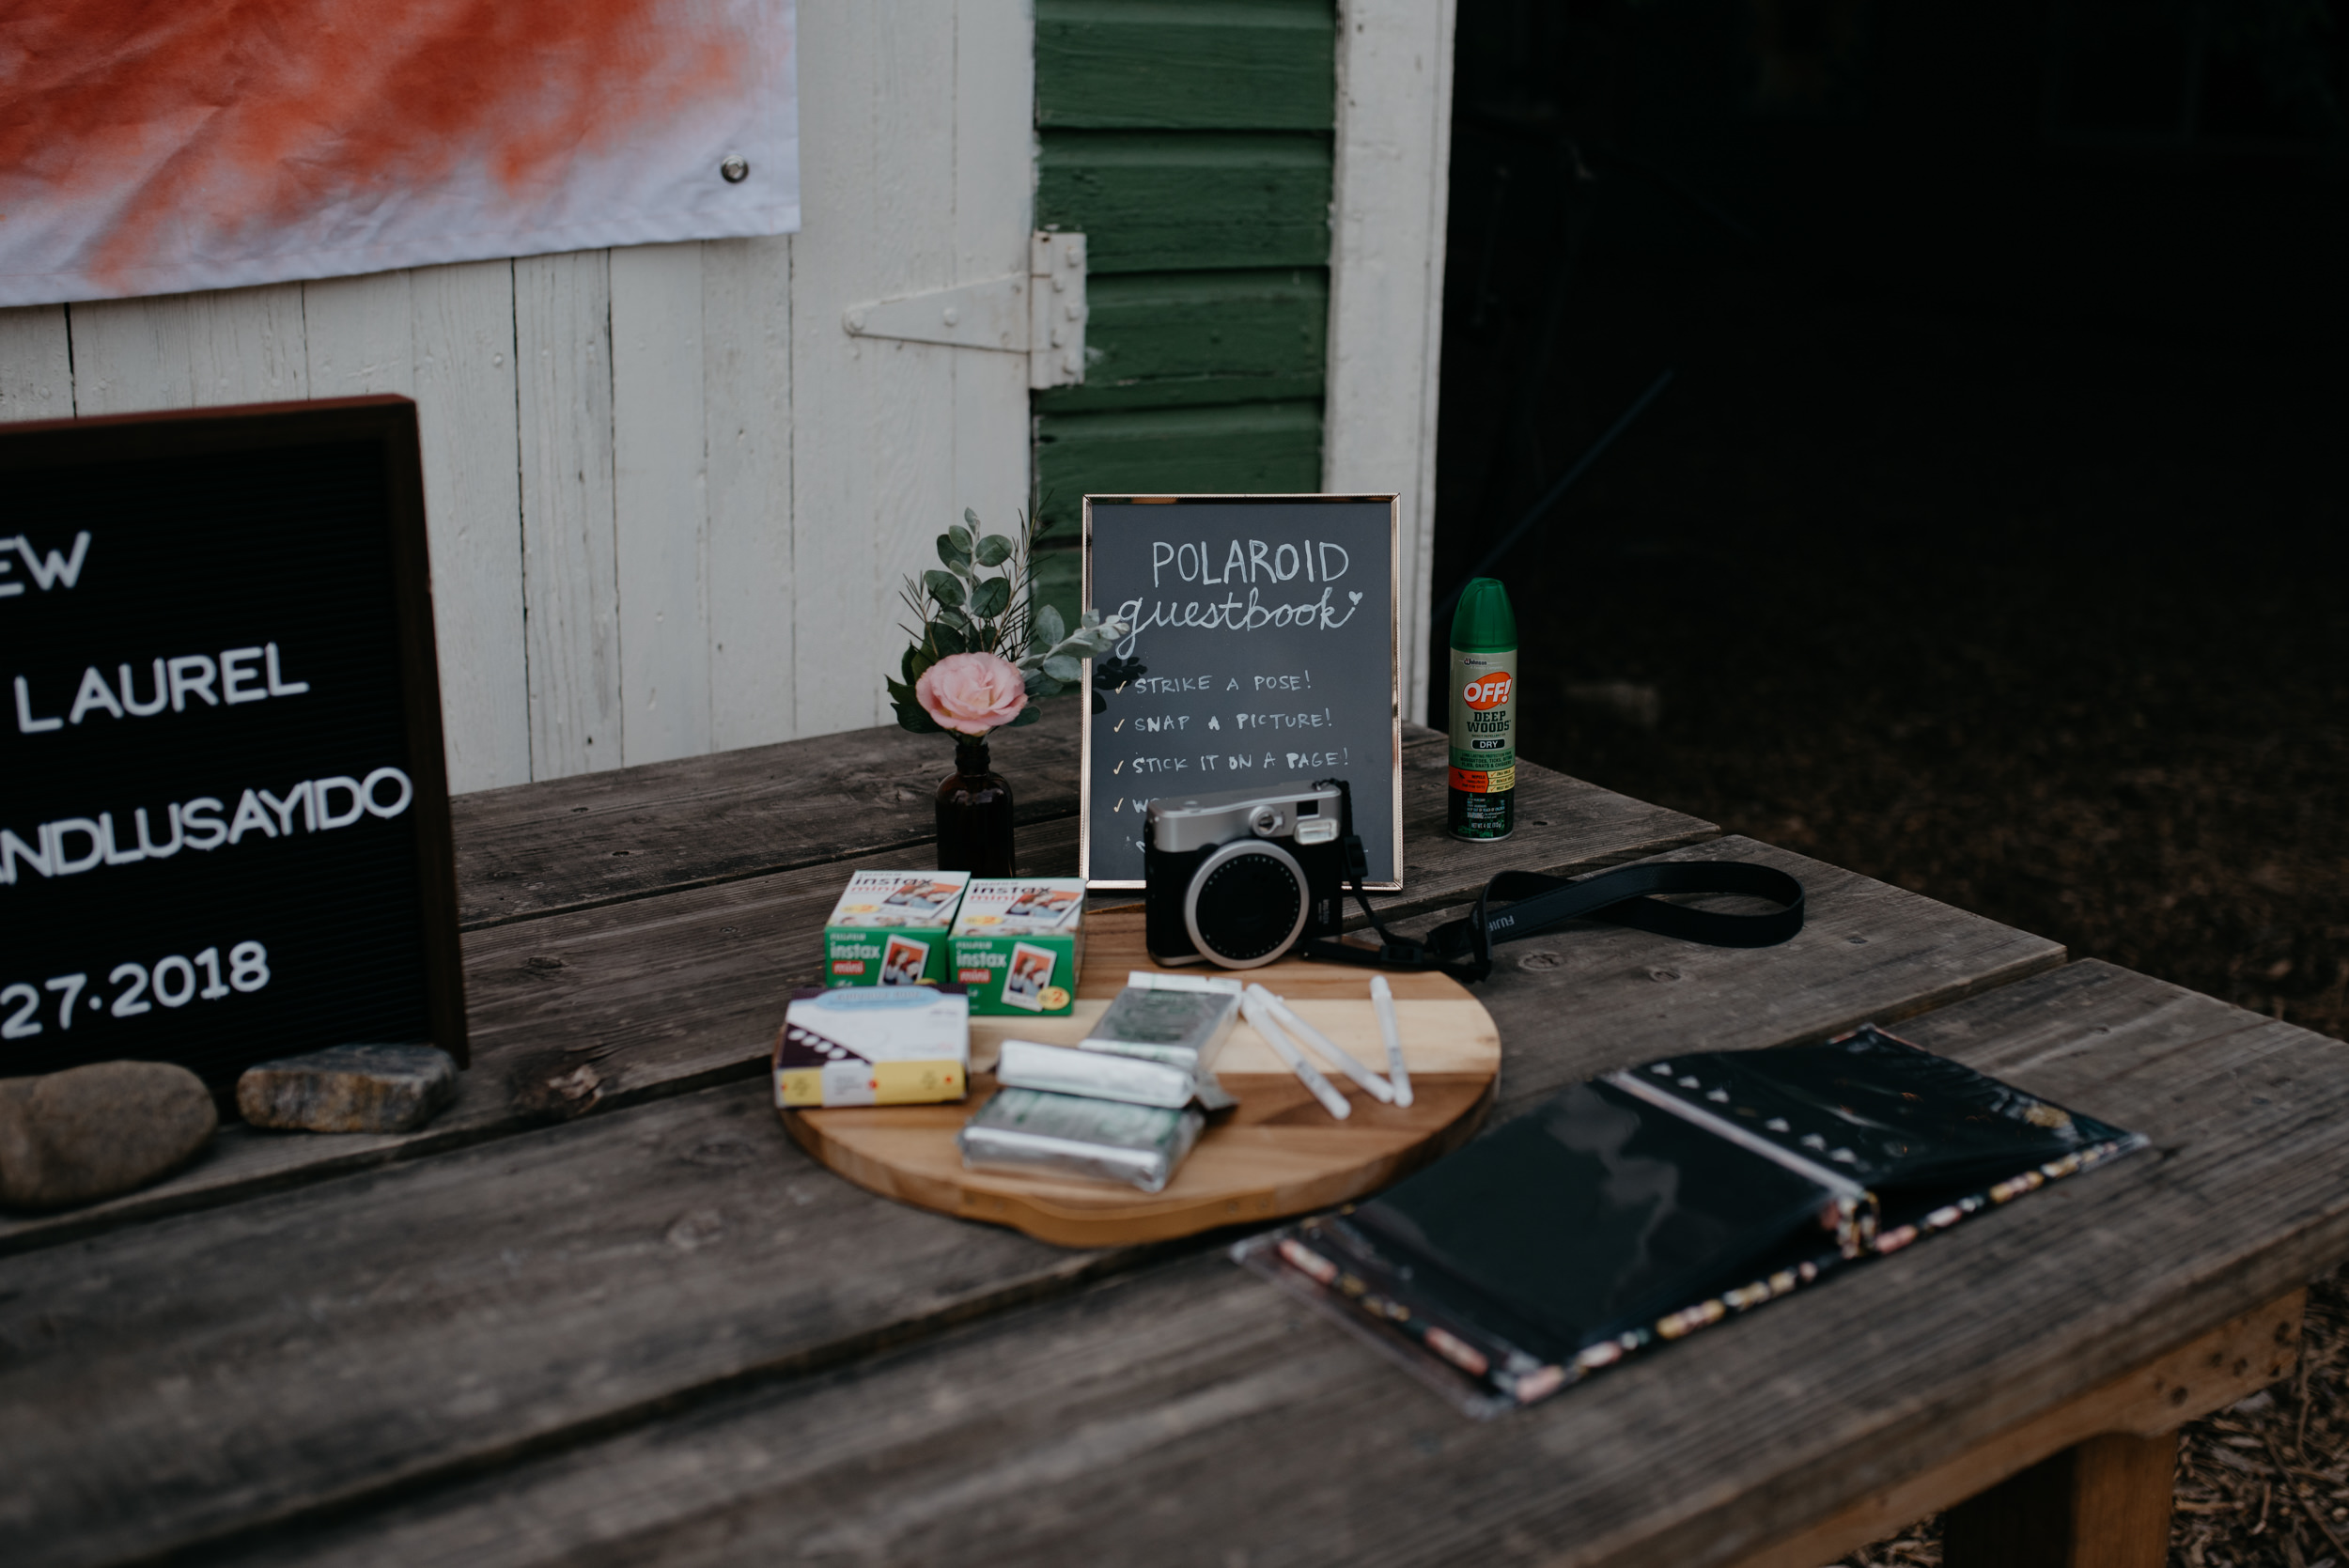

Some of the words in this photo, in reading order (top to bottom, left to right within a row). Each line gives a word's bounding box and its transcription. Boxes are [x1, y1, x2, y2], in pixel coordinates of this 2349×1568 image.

[1152, 539, 1349, 588] POLAROID
[1114, 586, 1356, 660] guestbook
[14, 642, 310, 734] LAUREL
[1134, 675, 1212, 694] STRIKE
[1226, 677, 1239, 691] A
[1254, 670, 1312, 691] POSE!
[1463, 678, 1512, 704] OFF!
[1134, 715, 1190, 733] SNAP
[1208, 716, 1221, 731] A
[1237, 707, 1333, 730] PICTURE!
[1474, 710, 1506, 722] DEEP
[1467, 720, 1510, 733] WOODS
[1479, 740, 1499, 749] DRY
[1132, 755, 1188, 773] STICK
[1201, 754, 1219, 771] IT
[1229, 753, 1252, 769] ON
[1264, 752, 1276, 768] A
[1285, 747, 1349, 768] PAGE!
[0, 767, 413, 885] NDLUSAYIDO
[855, 877, 934, 886] instax
[1487, 914, 1516, 932] FUJIF
[830, 940, 880, 959] instax
[956, 949, 1007, 968] instax
[833, 960, 863, 973] mini
[960, 969, 990, 983] mini
